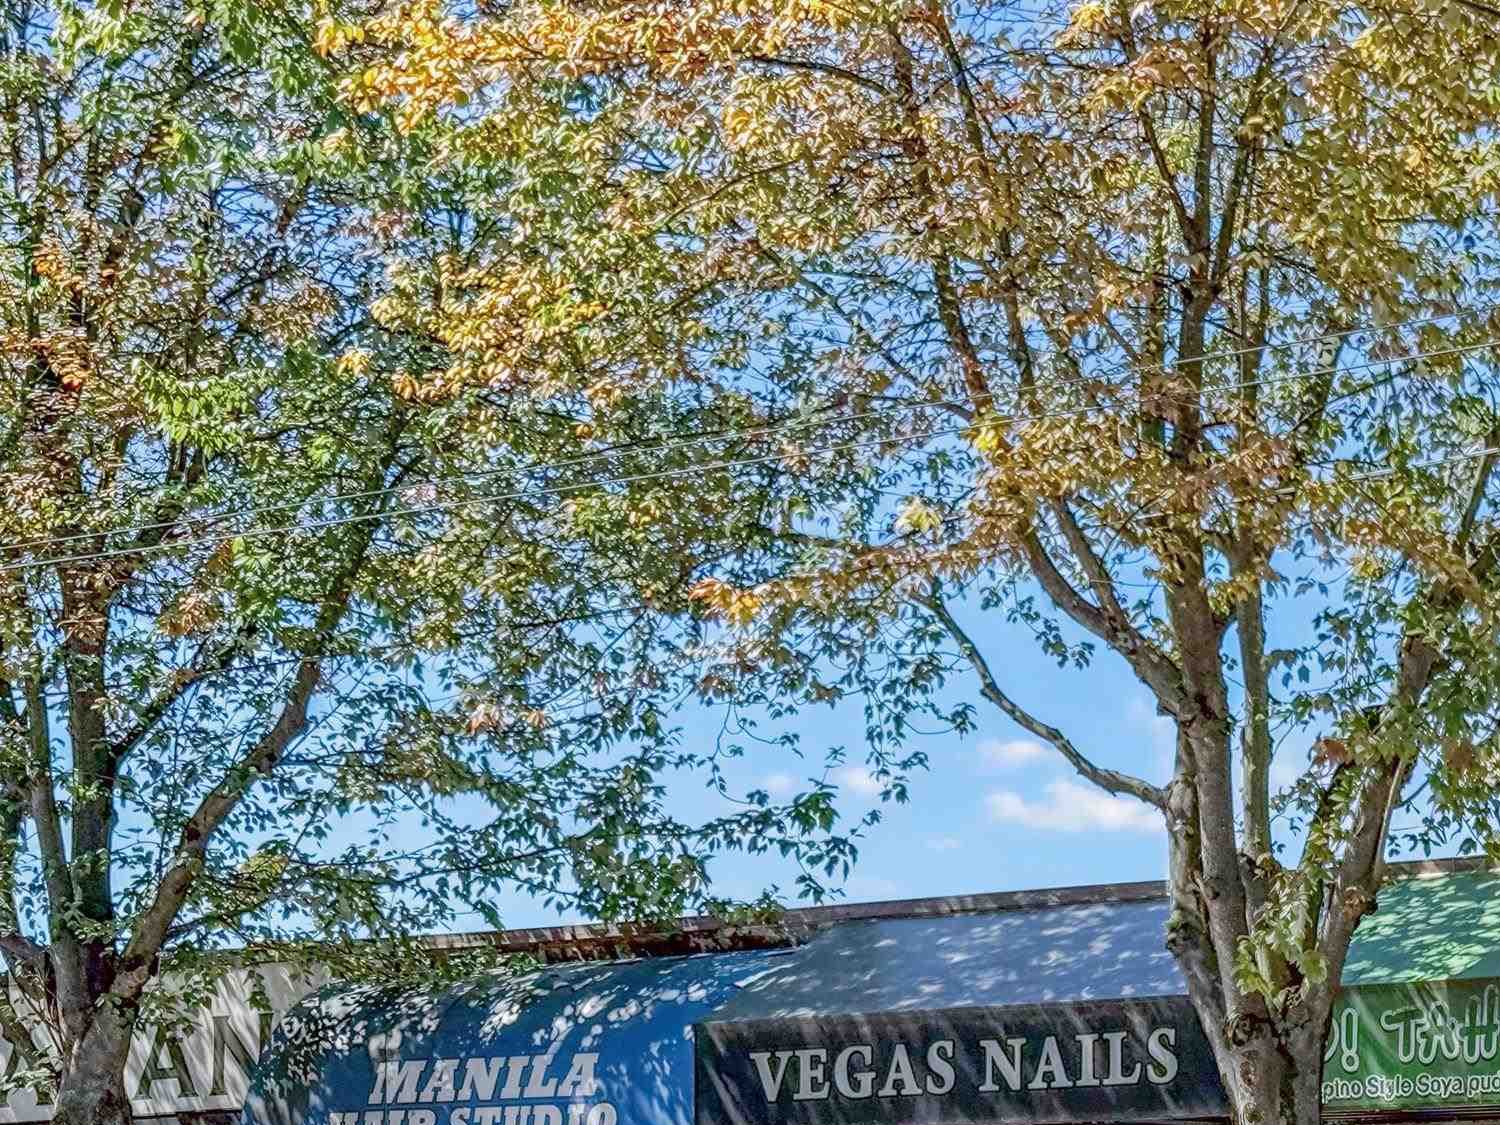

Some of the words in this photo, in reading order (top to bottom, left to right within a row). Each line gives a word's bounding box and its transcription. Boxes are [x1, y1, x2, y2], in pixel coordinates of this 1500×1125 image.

[368, 1052, 599, 1105] MANILA
[750, 1039, 956, 1102] VEGAS
[979, 1027, 1179, 1092] NAILS
[1322, 1080, 1362, 1104] pino
[1415, 1073, 1467, 1098] Soya
